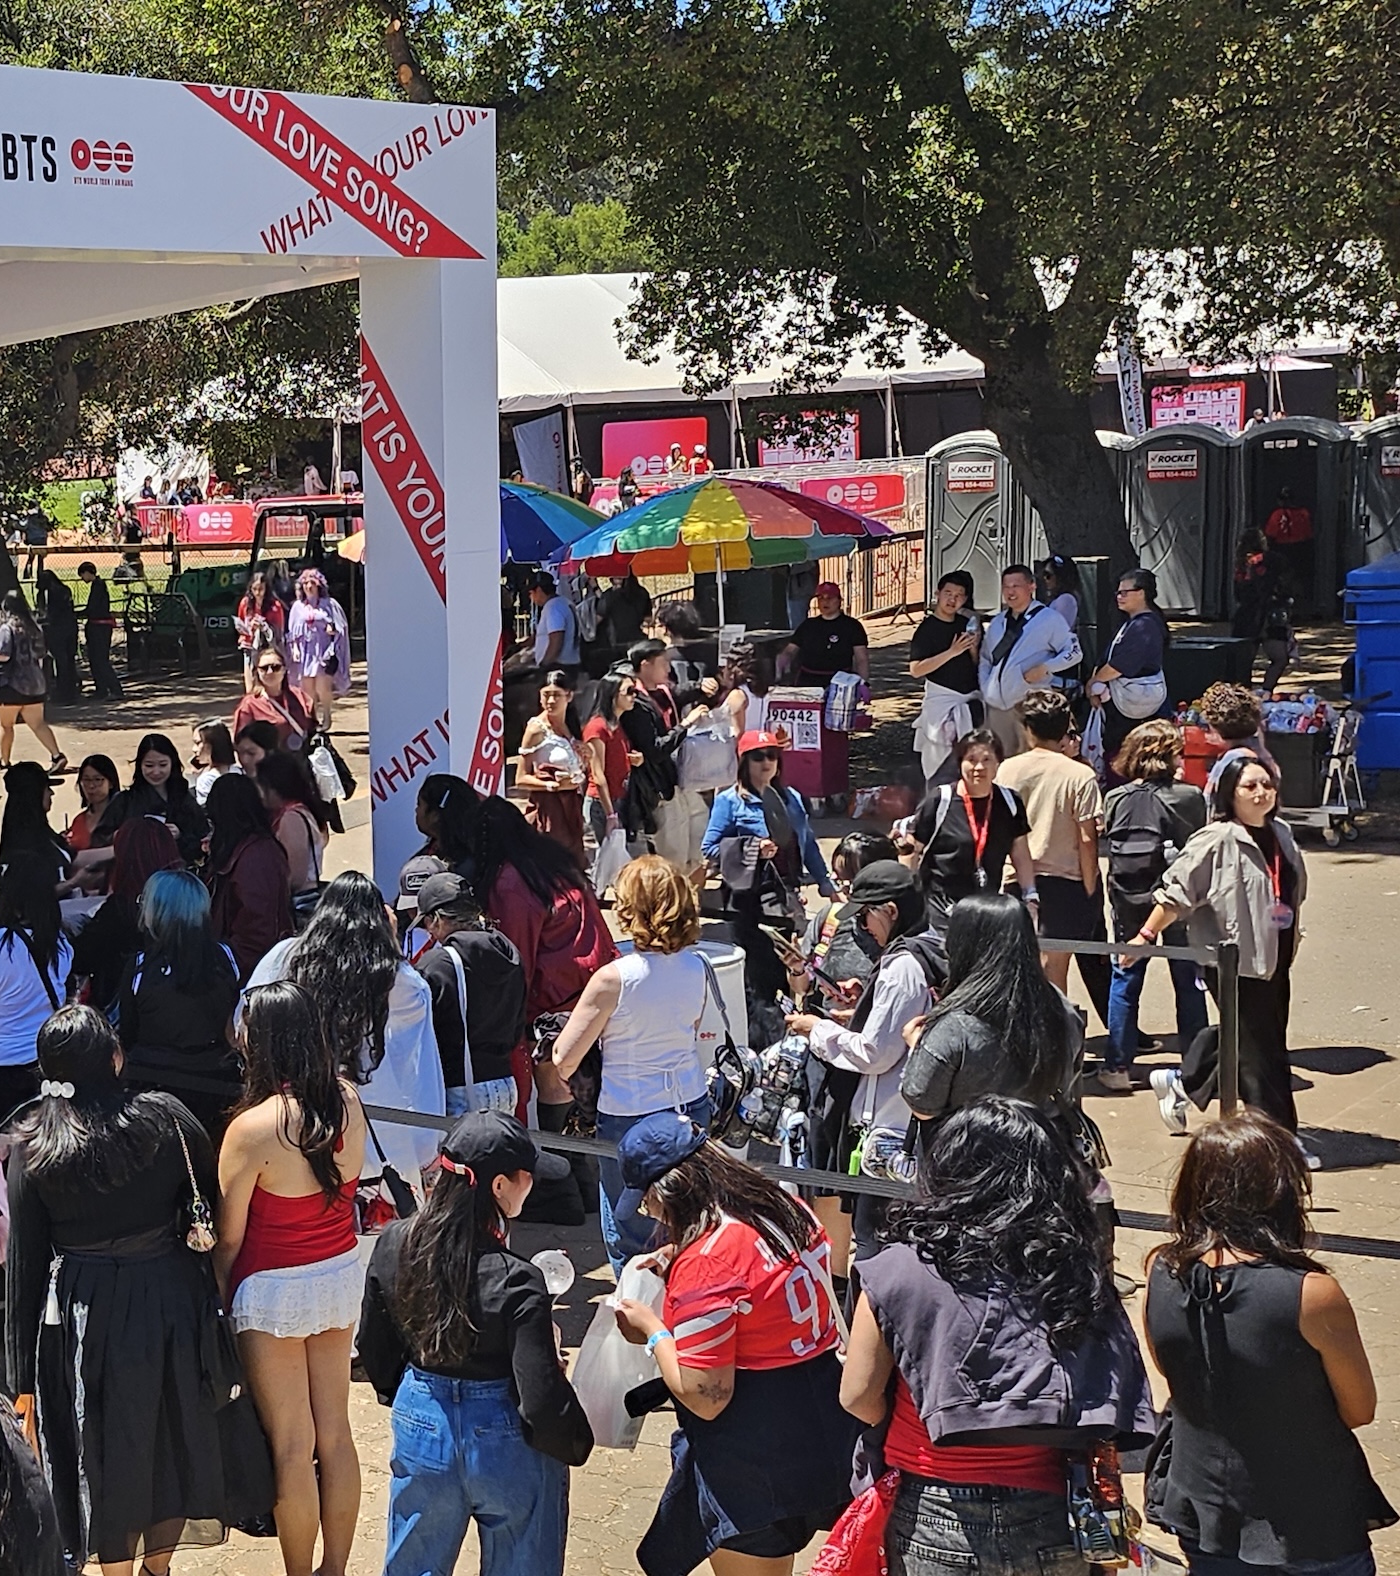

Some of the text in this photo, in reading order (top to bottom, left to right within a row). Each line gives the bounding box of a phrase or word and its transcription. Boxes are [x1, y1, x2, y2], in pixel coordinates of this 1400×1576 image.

[2, 133, 57, 183] BTS
[273, 109, 342, 188] LOVE
[343, 166, 430, 254] SONG?
[260, 192, 333, 255] WHAT
[372, 420, 407, 463] IS
[1158, 454, 1196, 463] ROCKET
[957, 465, 993, 474] ROCKET
